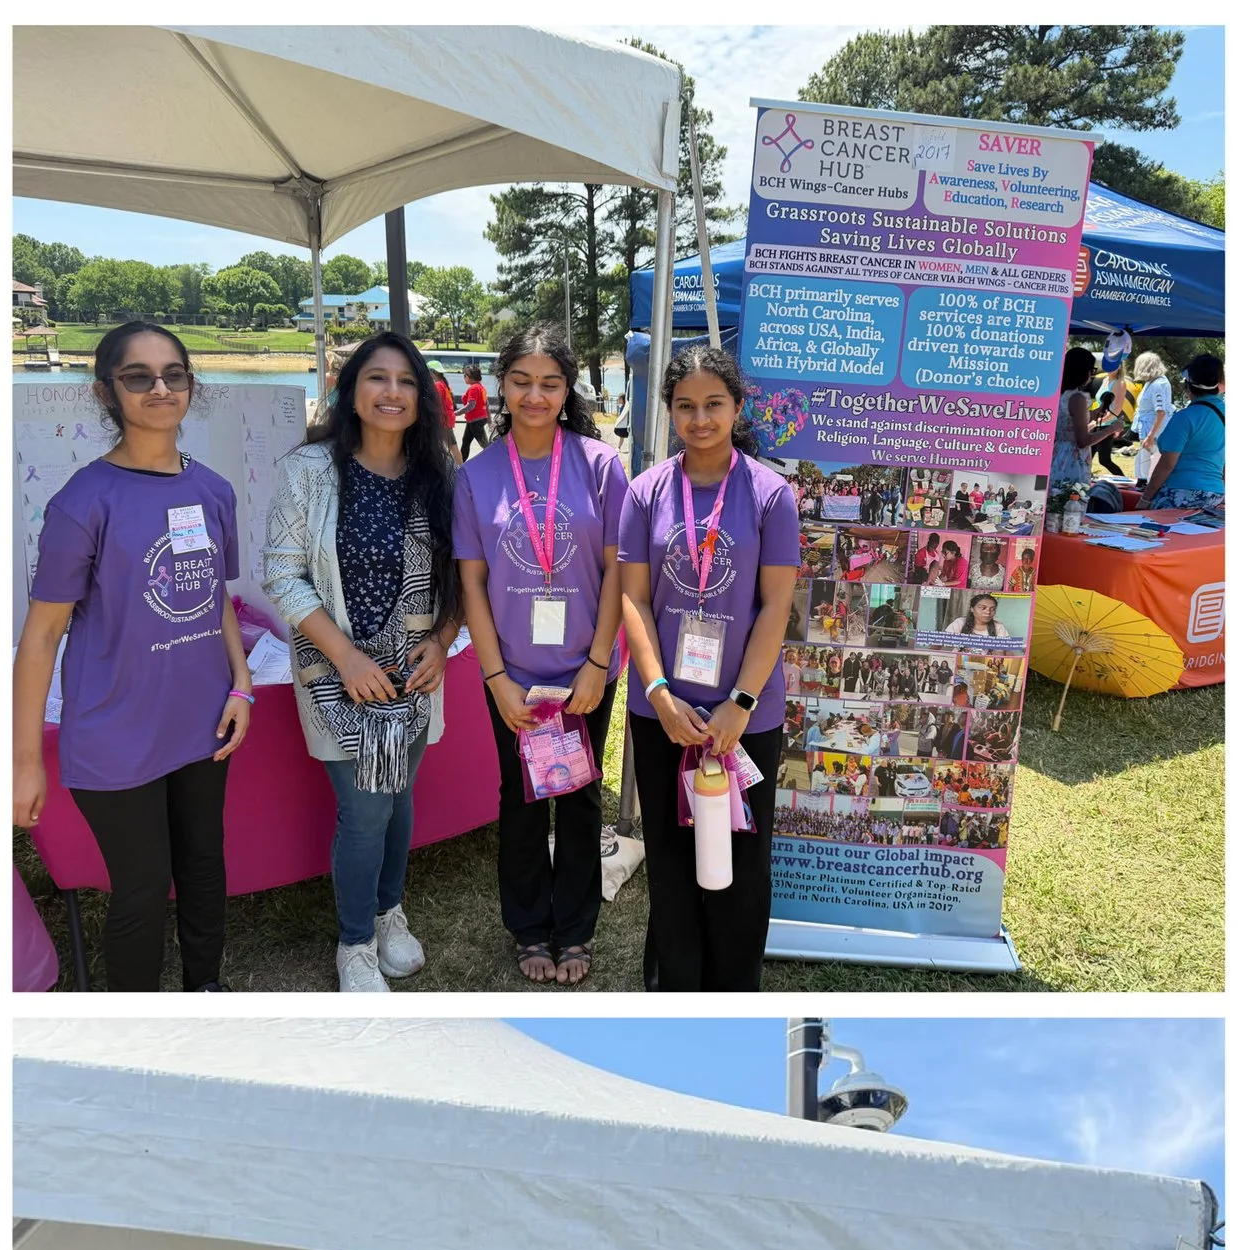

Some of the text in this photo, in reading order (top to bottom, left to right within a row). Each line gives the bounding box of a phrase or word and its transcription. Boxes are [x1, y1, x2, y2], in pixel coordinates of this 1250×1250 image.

[823, 118, 905, 143] BREAST
[821, 140, 911, 164] CANCER
[916, 144, 950, 160] 2017
[979, 134, 1042, 157] SAVER
[819, 161, 864, 180] HUB
[968, 160, 1049, 181] Save Lives By
[759, 176, 909, 200] BCH Wings-Cancer Hubs
[929, 173, 1080, 201] Awareness, Volunteering,
[944, 190, 1064, 214] Education, Research
[766, 202, 1068, 244] Grassroots Sustainable Solutions
[820, 228, 1019, 264] Saving Lives Globally
[755, 249, 1066, 282] BCH FIGHTS BREAST CANCER IN WOMEN, MEN & ALL GENDERS
[1094, 250, 1172, 277] CAROLINAS
[674, 273, 719, 288] CAROLIS
[749, 260, 1069, 292] BCH STANDS AGAINST ALL TYPES OF CANCER VIA BCH WINGS CANCER HUBS
[1095, 270, 1174, 294] ASIAN AMERICAN
[749, 284, 899, 307] BCH primarily serves
[939, 294, 1036, 313] 100% of BCH
[1091, 289, 1171, 307] CHAMBER OF COMMERCE
[766, 302, 875, 325] North Carolina,
[919, 308, 1054, 330] services are FREE
[759, 323, 885, 343] across USA, India,
[926, 324, 1045, 345] 100% donations
[756, 338, 879, 361] Africa, & Globally
[908, 338, 1054, 361] driven towards our
[751, 354, 884, 375] with Hybrid Model
[949, 356, 1009, 373] Mission
[915, 368, 1041, 392] (Donor's choice)
[25, 385, 89, 405] HONOR
[811, 388, 1052, 422] #TogetherWeSaveLives
[812, 414, 834, 426] We
[836, 417, 868, 429] stand
[871, 419, 913, 434] against
[915, 421, 1005, 438] discrimination
[1007, 426, 1019, 438] of
[816, 430, 1042, 456] Religion, Language, Culture & Gender.
[871, 449, 991, 470] We serve Humanity
[559, 503, 574, 517] HUBS
[663, 528, 735, 547] BCH HUBS
[143, 547, 155, 563] BCH
[175, 558, 212, 571] BREAST
[501, 540, 578, 571] GRASSROOTS SOLUTIONS
[176, 583, 200, 592] HUB
[716, 570, 737, 594] SOLUTIONS
[143, 592, 172, 620] GRASSROOT
[770, 842, 974, 866] arn about our Global impact
[770, 855, 983, 883] www.breastcancerhub.org
[820, 874, 865, 886] Platinum
[869, 879, 912, 888] Certified
[916, 880, 923, 888] &
[927, 880, 981, 893] Top-Rated
[841, 886, 961, 903] Volunteer Organization,
[773, 891, 796, 901] ered
[799, 893, 808, 901] in
[811, 893, 841, 904] North
[893, 900, 913, 909] USA
[917, 901, 926, 909] in
[929, 902, 953, 911] 2017
